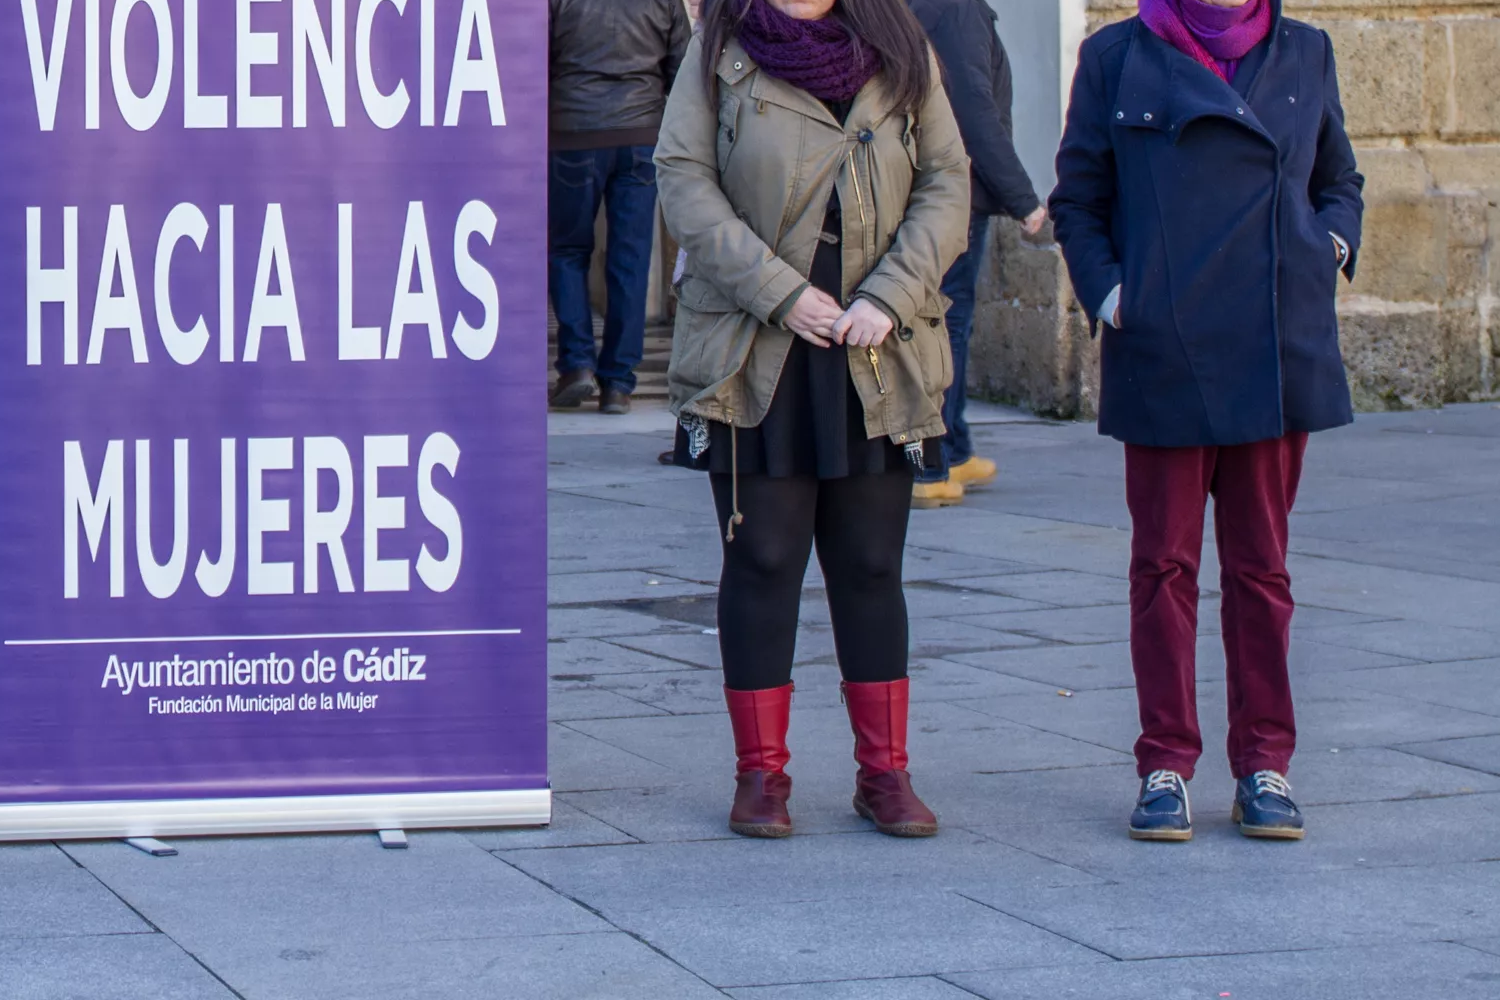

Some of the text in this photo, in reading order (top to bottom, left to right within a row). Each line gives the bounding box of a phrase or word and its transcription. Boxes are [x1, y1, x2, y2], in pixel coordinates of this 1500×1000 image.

[26, 199, 500, 366] HACIA LAS
[63, 431, 463, 599] MUJERES
[101, 646, 427, 695] Ayuntamiento de Cádiz
[148, 691, 379, 715] Fundación Municipal de la Mujer
